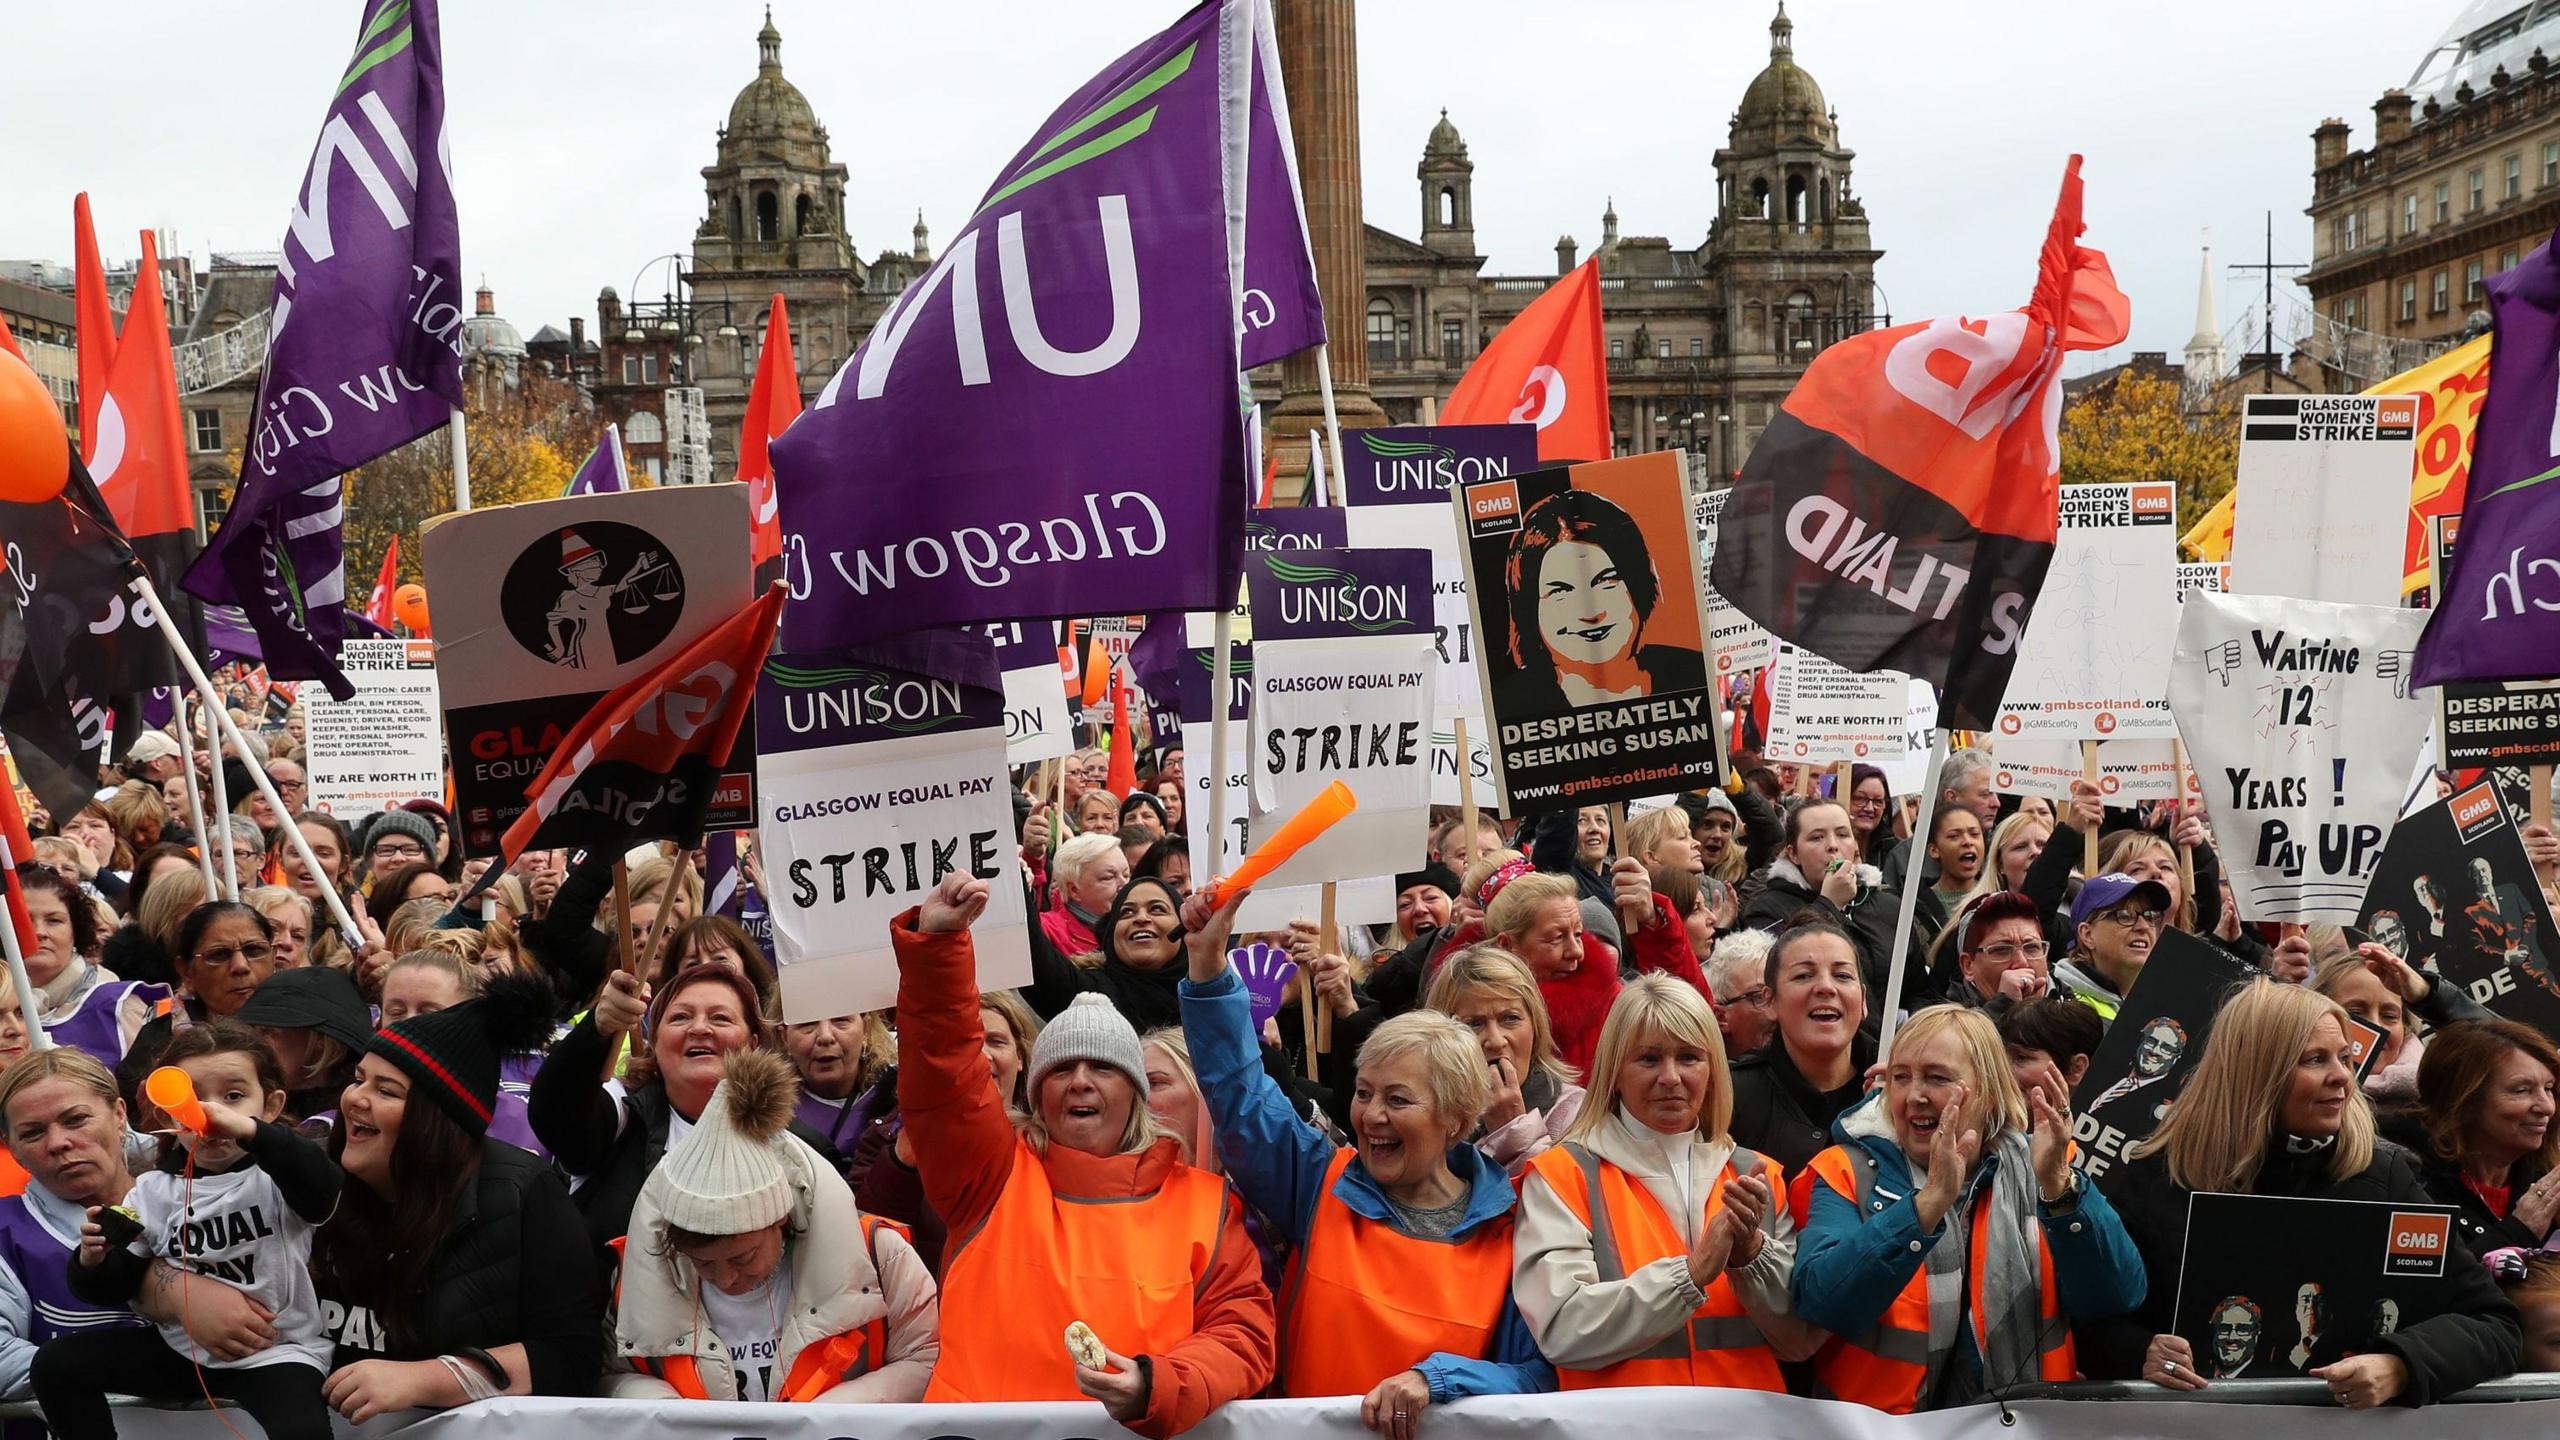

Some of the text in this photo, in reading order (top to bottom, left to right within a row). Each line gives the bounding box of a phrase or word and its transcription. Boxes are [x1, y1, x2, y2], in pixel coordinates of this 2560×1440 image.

[2301, 399, 2376, 411] GLASGOW
[2300, 412, 2375, 424] WOMEN'S
[2382, 411, 2410, 423] GMB
[2298, 426, 2374, 441] STRIKE
[1375, 456, 1508, 492] UNISON
[2059, 487, 2129, 500] LASGOW
[1476, 497, 1513, 514] GMB
[2136, 497, 2167, 509] GMB
[1480, 518, 1513, 528] SCOTLAND
[1246, 533, 1322, 550] ISON
[2176, 566, 2217, 578] SGOW
[1280, 584, 1407, 624] UNISON
[1711, 622, 1747, 640] ORTH
[345, 642, 404, 651] GLASGOW
[346, 651, 405, 660] WOMEN'S
[409, 650, 432, 659] GMB
[346, 660, 405, 671] STRIKE
[1266, 676, 1344, 693] GLASGOW
[1348, 674, 1394, 689] EQUAL
[1398, 673, 1423, 688] PAY
[312, 708, 354, 716] CLEANER,
[785, 679, 961, 733] UNISON
[2003, 698, 2170, 713] www.gmbscotland.org
[2279, 685, 2314, 726] 12
[312, 717, 359, 725] HYGIENIST,
[1502, 696, 1702, 745] DESPERATELY
[1796, 716, 1903, 725] WE ARE WORTH IT!
[2024, 719, 2078, 729] @GMBScotOrg
[2119, 718, 2172, 728] /GMBScotland
[2449, 716, 2539, 734] SEEKING
[312, 725, 349, 733] KEEPER,
[386, 732, 428, 740] SHOPPER,
[1796, 732, 1903, 743] www.gmbscotland.org
[1267, 721, 1419, 775] STRIKE
[1507, 737, 1617, 770] SEEKING
[1624, 723, 1709, 752] SUSAN
[475, 757, 545, 782] EQUA
[314, 772, 437, 783] WE ARE WORTH IT!
[1513, 760, 1713, 800] www.gmbscotland.org
[317, 790, 439, 800] www.gmbscotland.org
[2225, 767, 2307, 810] YEARS
[711, 789, 742, 804] MB
[775, 776, 994, 823] GLASGOW EQUAL PAY
[2459, 798, 2491, 821] GMB
[2467, 816, 2495, 834] SCOTLAND
[2319, 823, 2384, 879] UP!
[789, 829, 1000, 908] STRIKE
[168, 1205, 274, 1257] EQUAL
[2397, 1232, 2439, 1248] GMB
[2396, 1259, 2434, 1267] SCOTLAND
[320, 1299, 386, 1352] PAY
